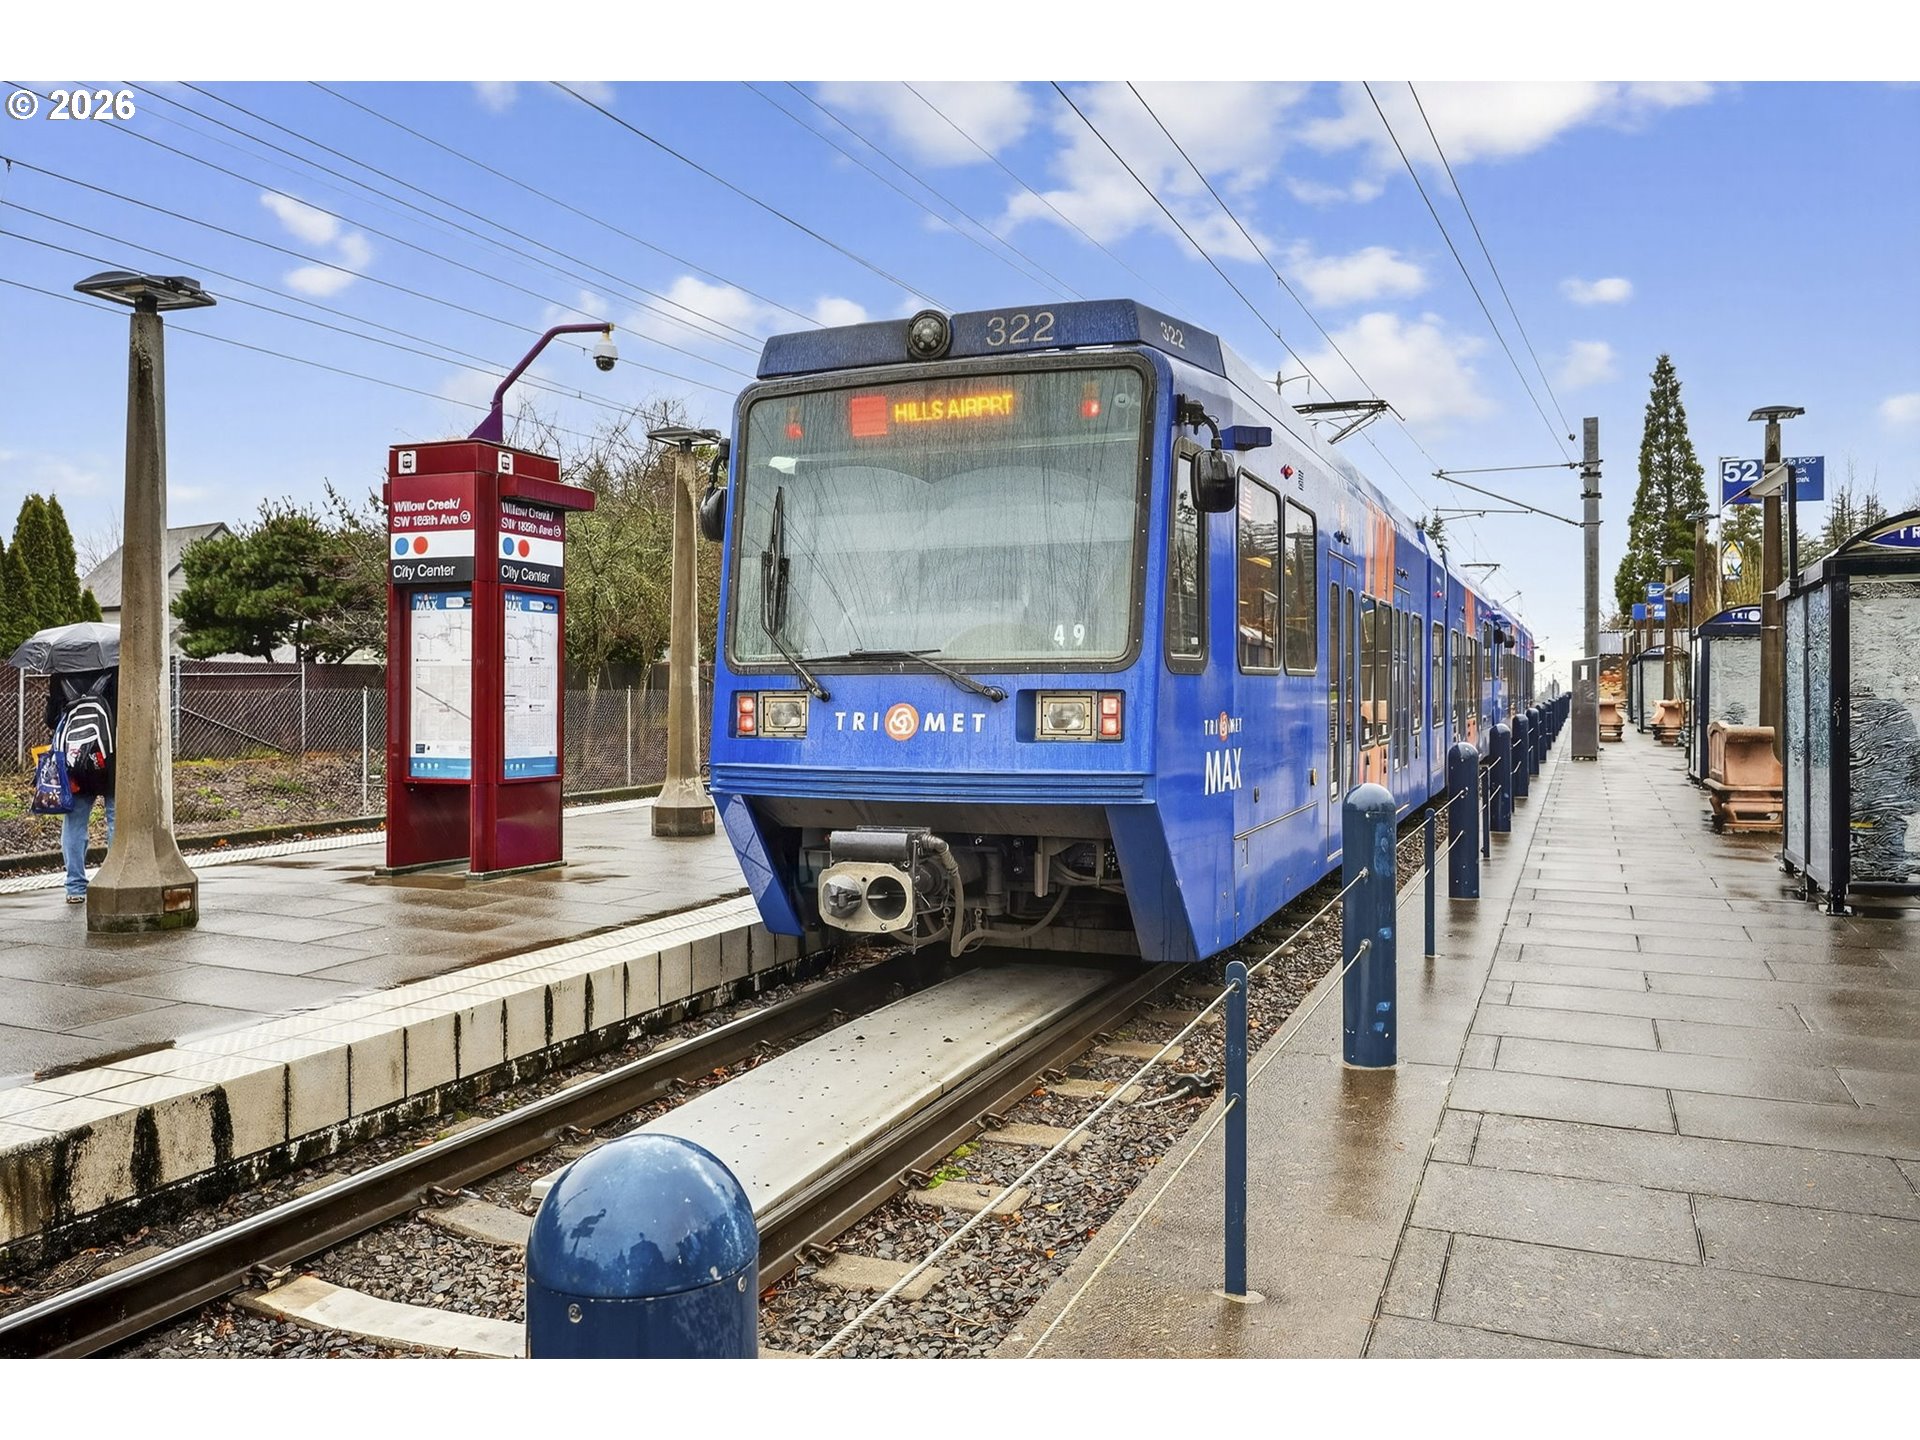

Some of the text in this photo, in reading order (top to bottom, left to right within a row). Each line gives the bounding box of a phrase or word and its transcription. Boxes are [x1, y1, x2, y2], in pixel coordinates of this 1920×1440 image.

[986, 311, 1055, 346] 322
[1160, 321, 1186, 350] 322
[894, 401, 944, 423] HILLS
[1723, 461, 1759, 482] 52
[393, 501, 425, 512] Willow
[393, 516, 411, 527] SW
[439, 513, 459, 525] Ave
[501, 517, 517, 530] SW
[393, 563, 456, 581] City Center
[501, 564, 551, 584] City Center
[1203, 747, 1242, 796] MAX
